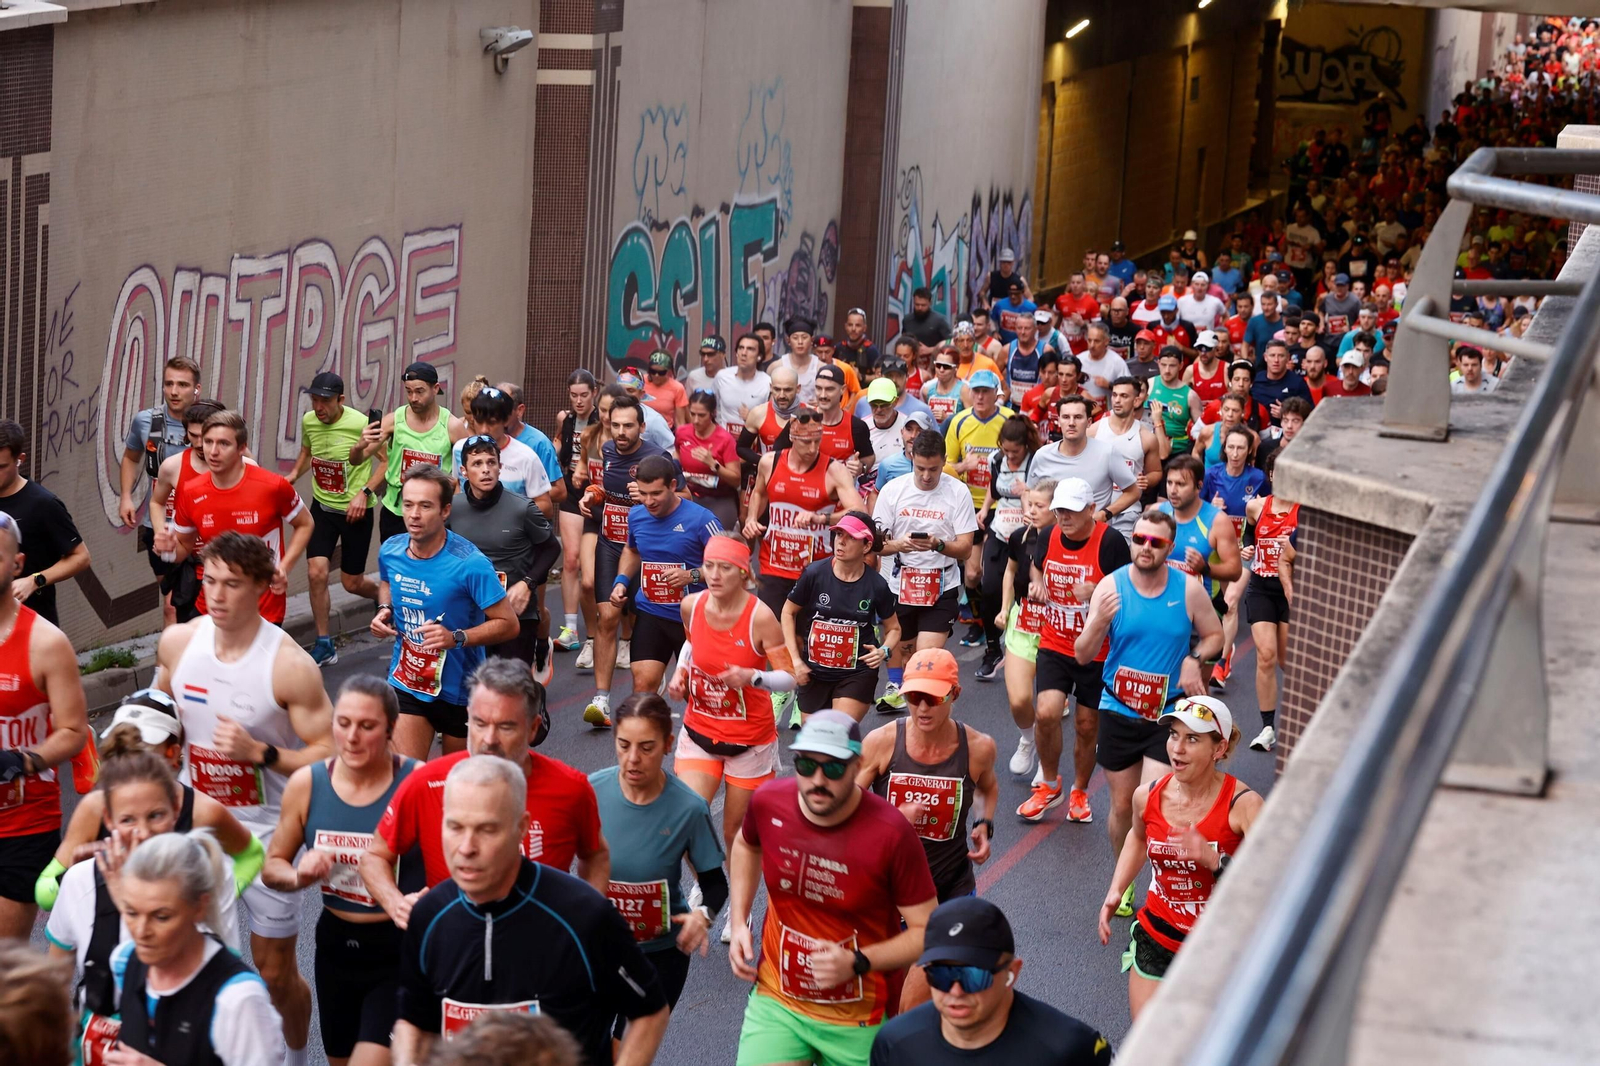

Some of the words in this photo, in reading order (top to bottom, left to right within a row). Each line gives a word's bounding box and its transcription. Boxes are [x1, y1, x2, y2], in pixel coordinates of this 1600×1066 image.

[911, 508, 945, 521] TERREX
[910, 576, 932, 585] 4224
[822, 622, 852, 633] GENERALI
[819, 633, 844, 645] 9105
[1128, 671, 1162, 684] GENERALI
[1126, 681, 1152, 695] 9180
[200, 761, 243, 777] 10006
[908, 777, 952, 790] GENERALI
[904, 790, 940, 806] 9326
